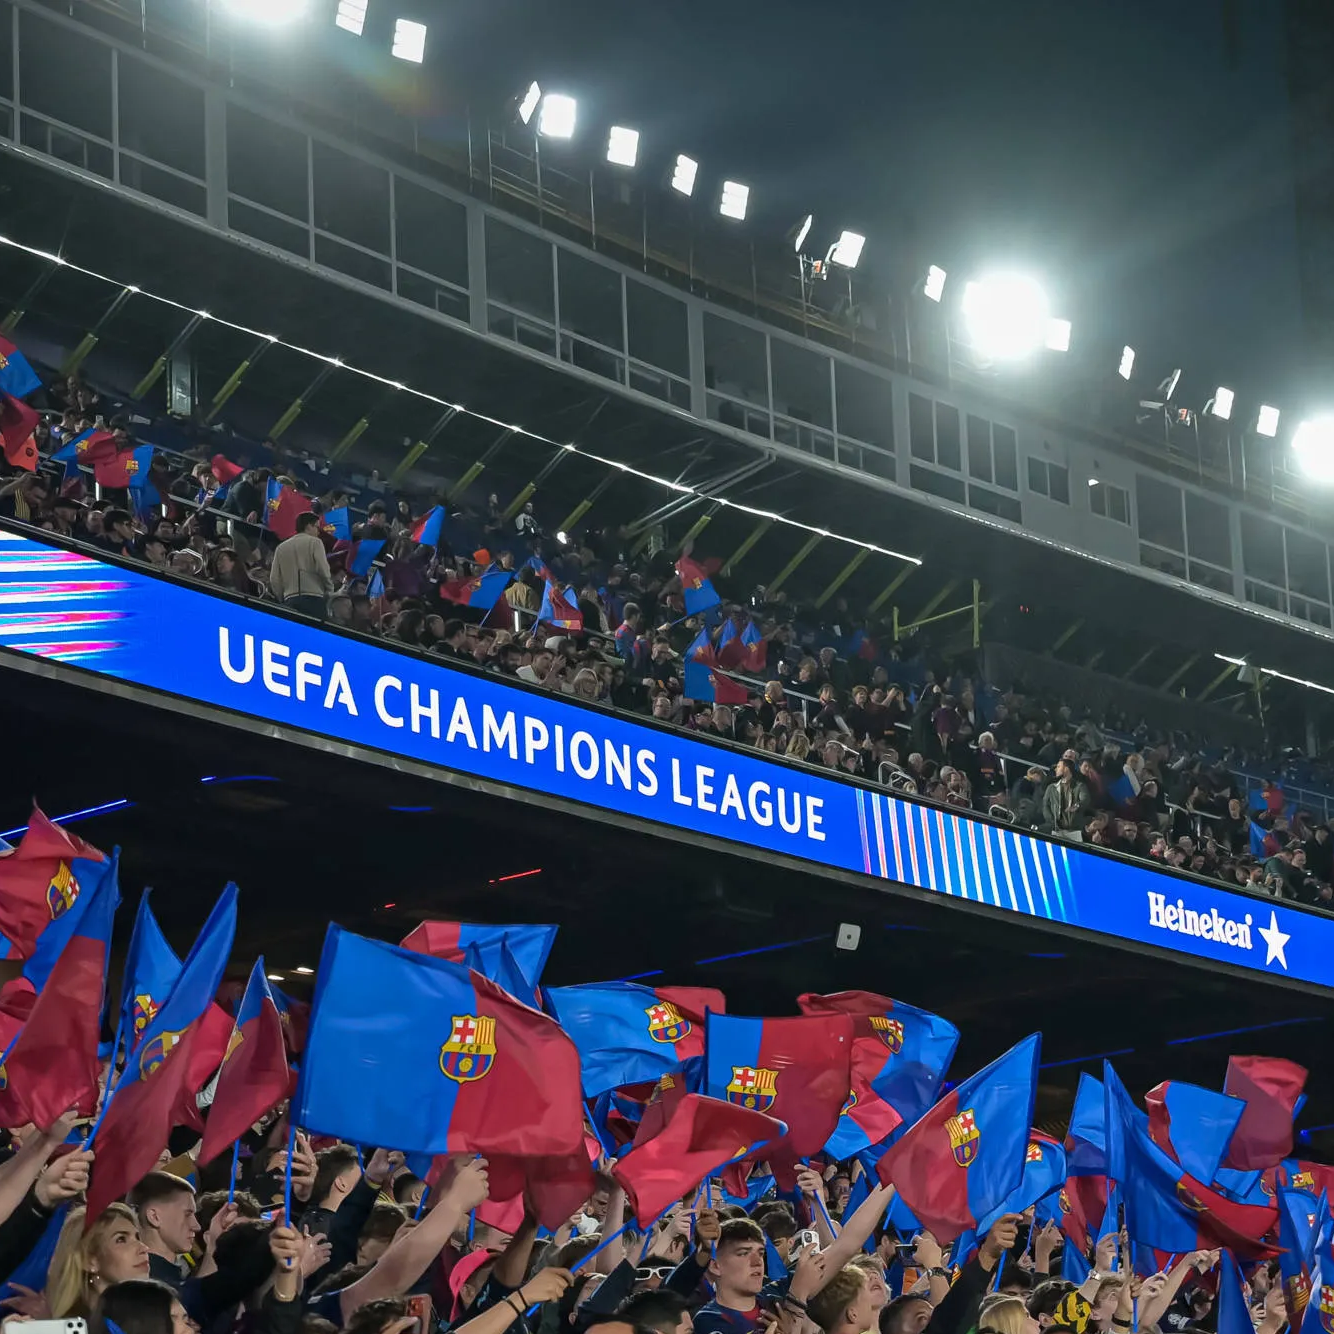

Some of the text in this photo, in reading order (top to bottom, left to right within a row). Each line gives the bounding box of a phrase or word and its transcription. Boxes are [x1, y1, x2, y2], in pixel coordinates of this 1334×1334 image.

[218, 626, 826, 842] UEFA CHAMPIONS LEAGUE
[1147, 891, 1252, 950] Heineken
[458, 1043, 482, 1054] FCB
